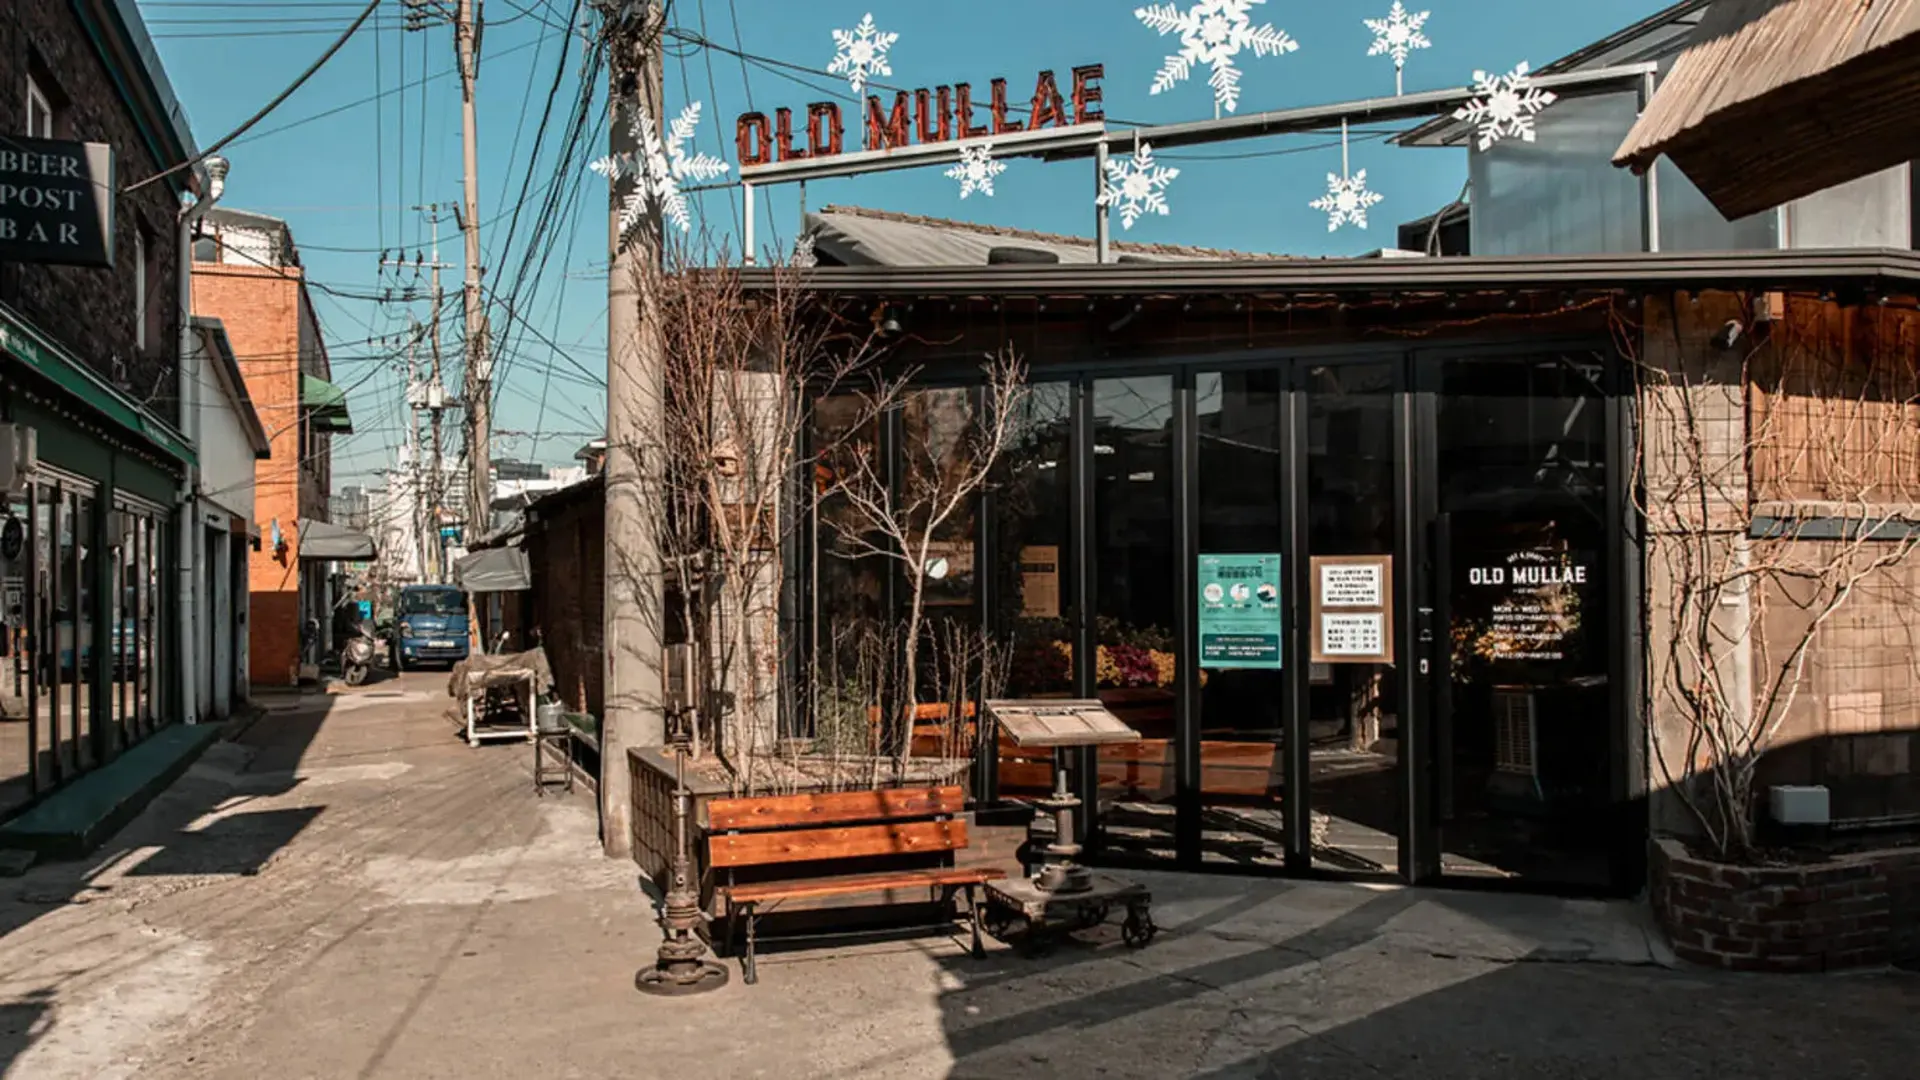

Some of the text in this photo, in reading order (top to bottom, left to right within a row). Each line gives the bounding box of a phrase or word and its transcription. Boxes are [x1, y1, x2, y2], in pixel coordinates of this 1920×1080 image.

[736, 63, 1105, 167] OLD MULLAE
[0, 150, 80, 178] BEER
[0, 184, 83, 211] POST
[0, 218, 79, 245] BAR
[1469, 565, 1587, 585] OLD MULLAE
[1493, 605, 1511, 613] MON
[1522, 605, 1540, 613] WED
